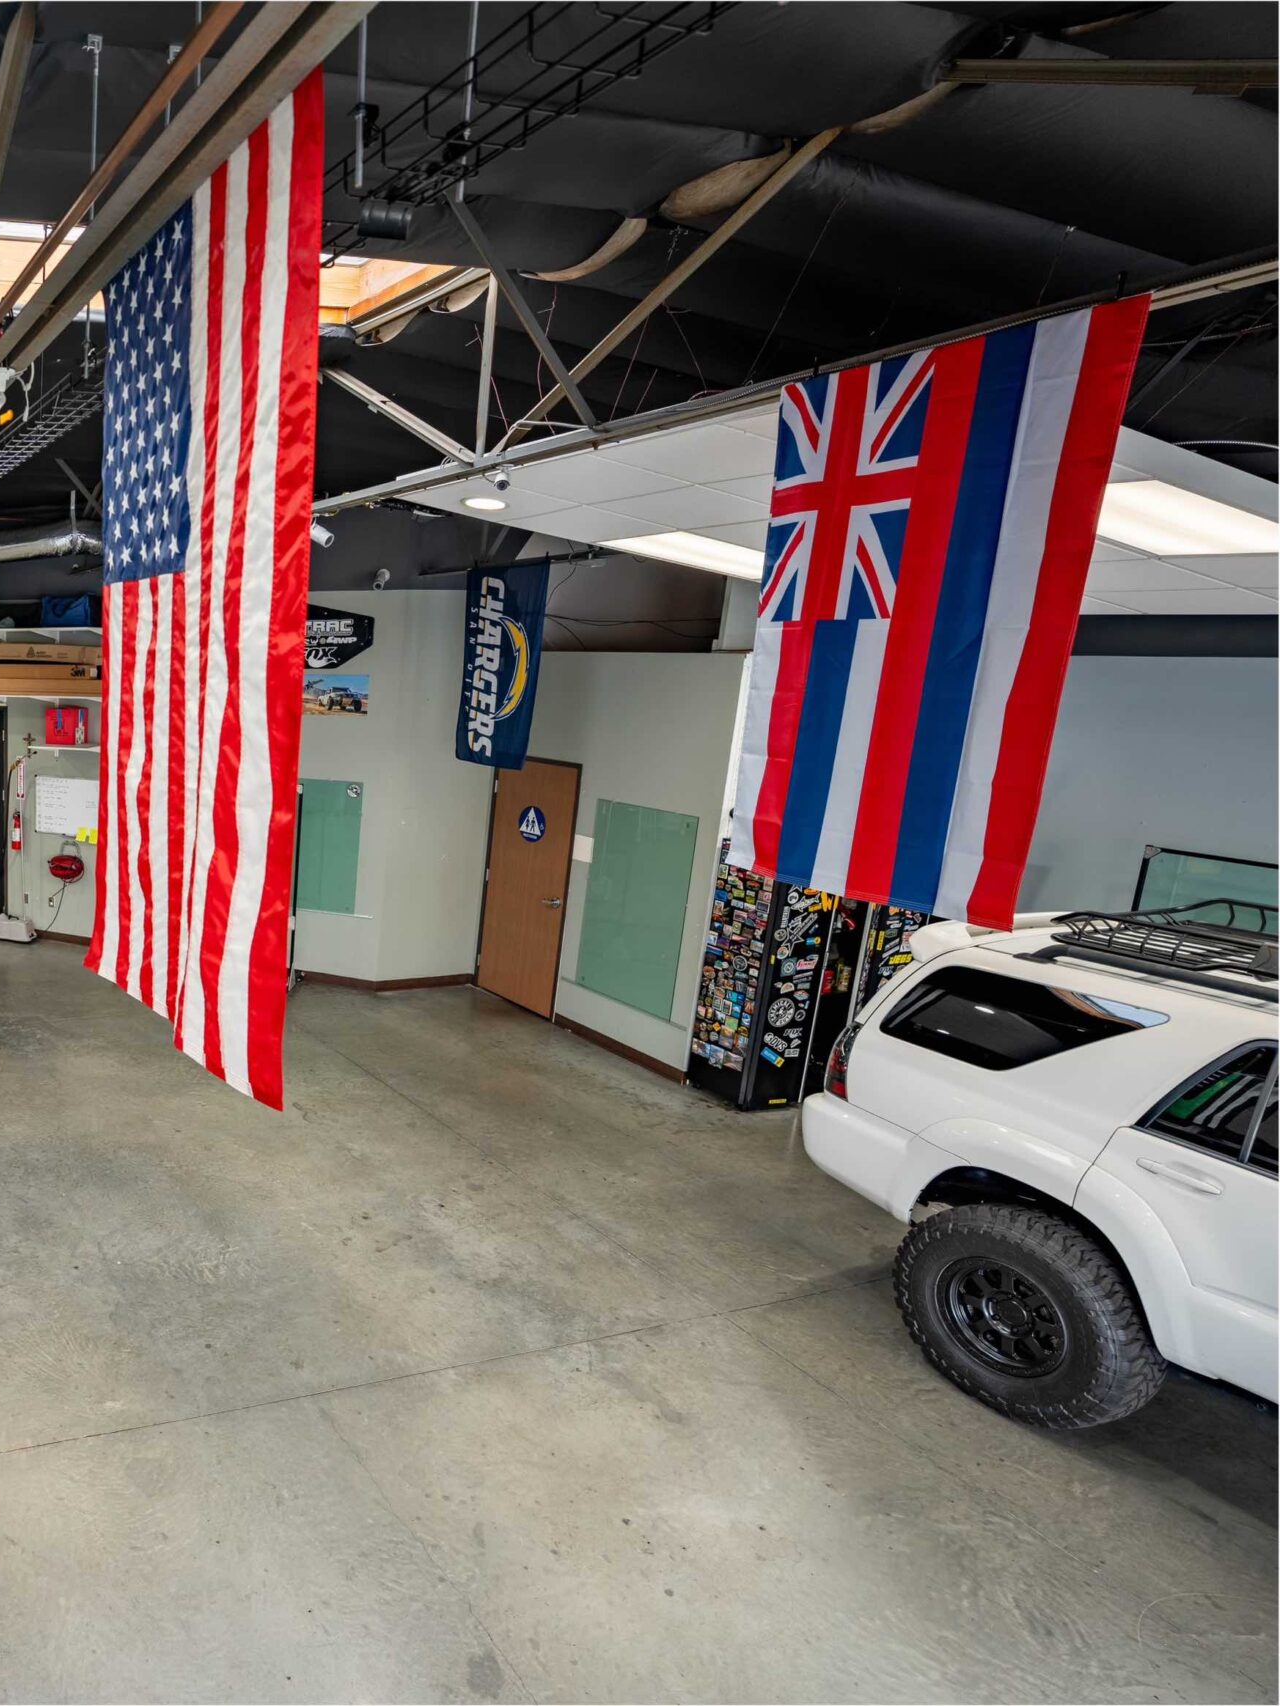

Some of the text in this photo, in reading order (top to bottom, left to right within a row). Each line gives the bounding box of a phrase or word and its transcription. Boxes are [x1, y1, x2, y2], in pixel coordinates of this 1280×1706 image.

[469, 607, 479, 644] SAN
[70, 667, 86, 677] 3M
[468, 576, 506, 757] CHARGERS
